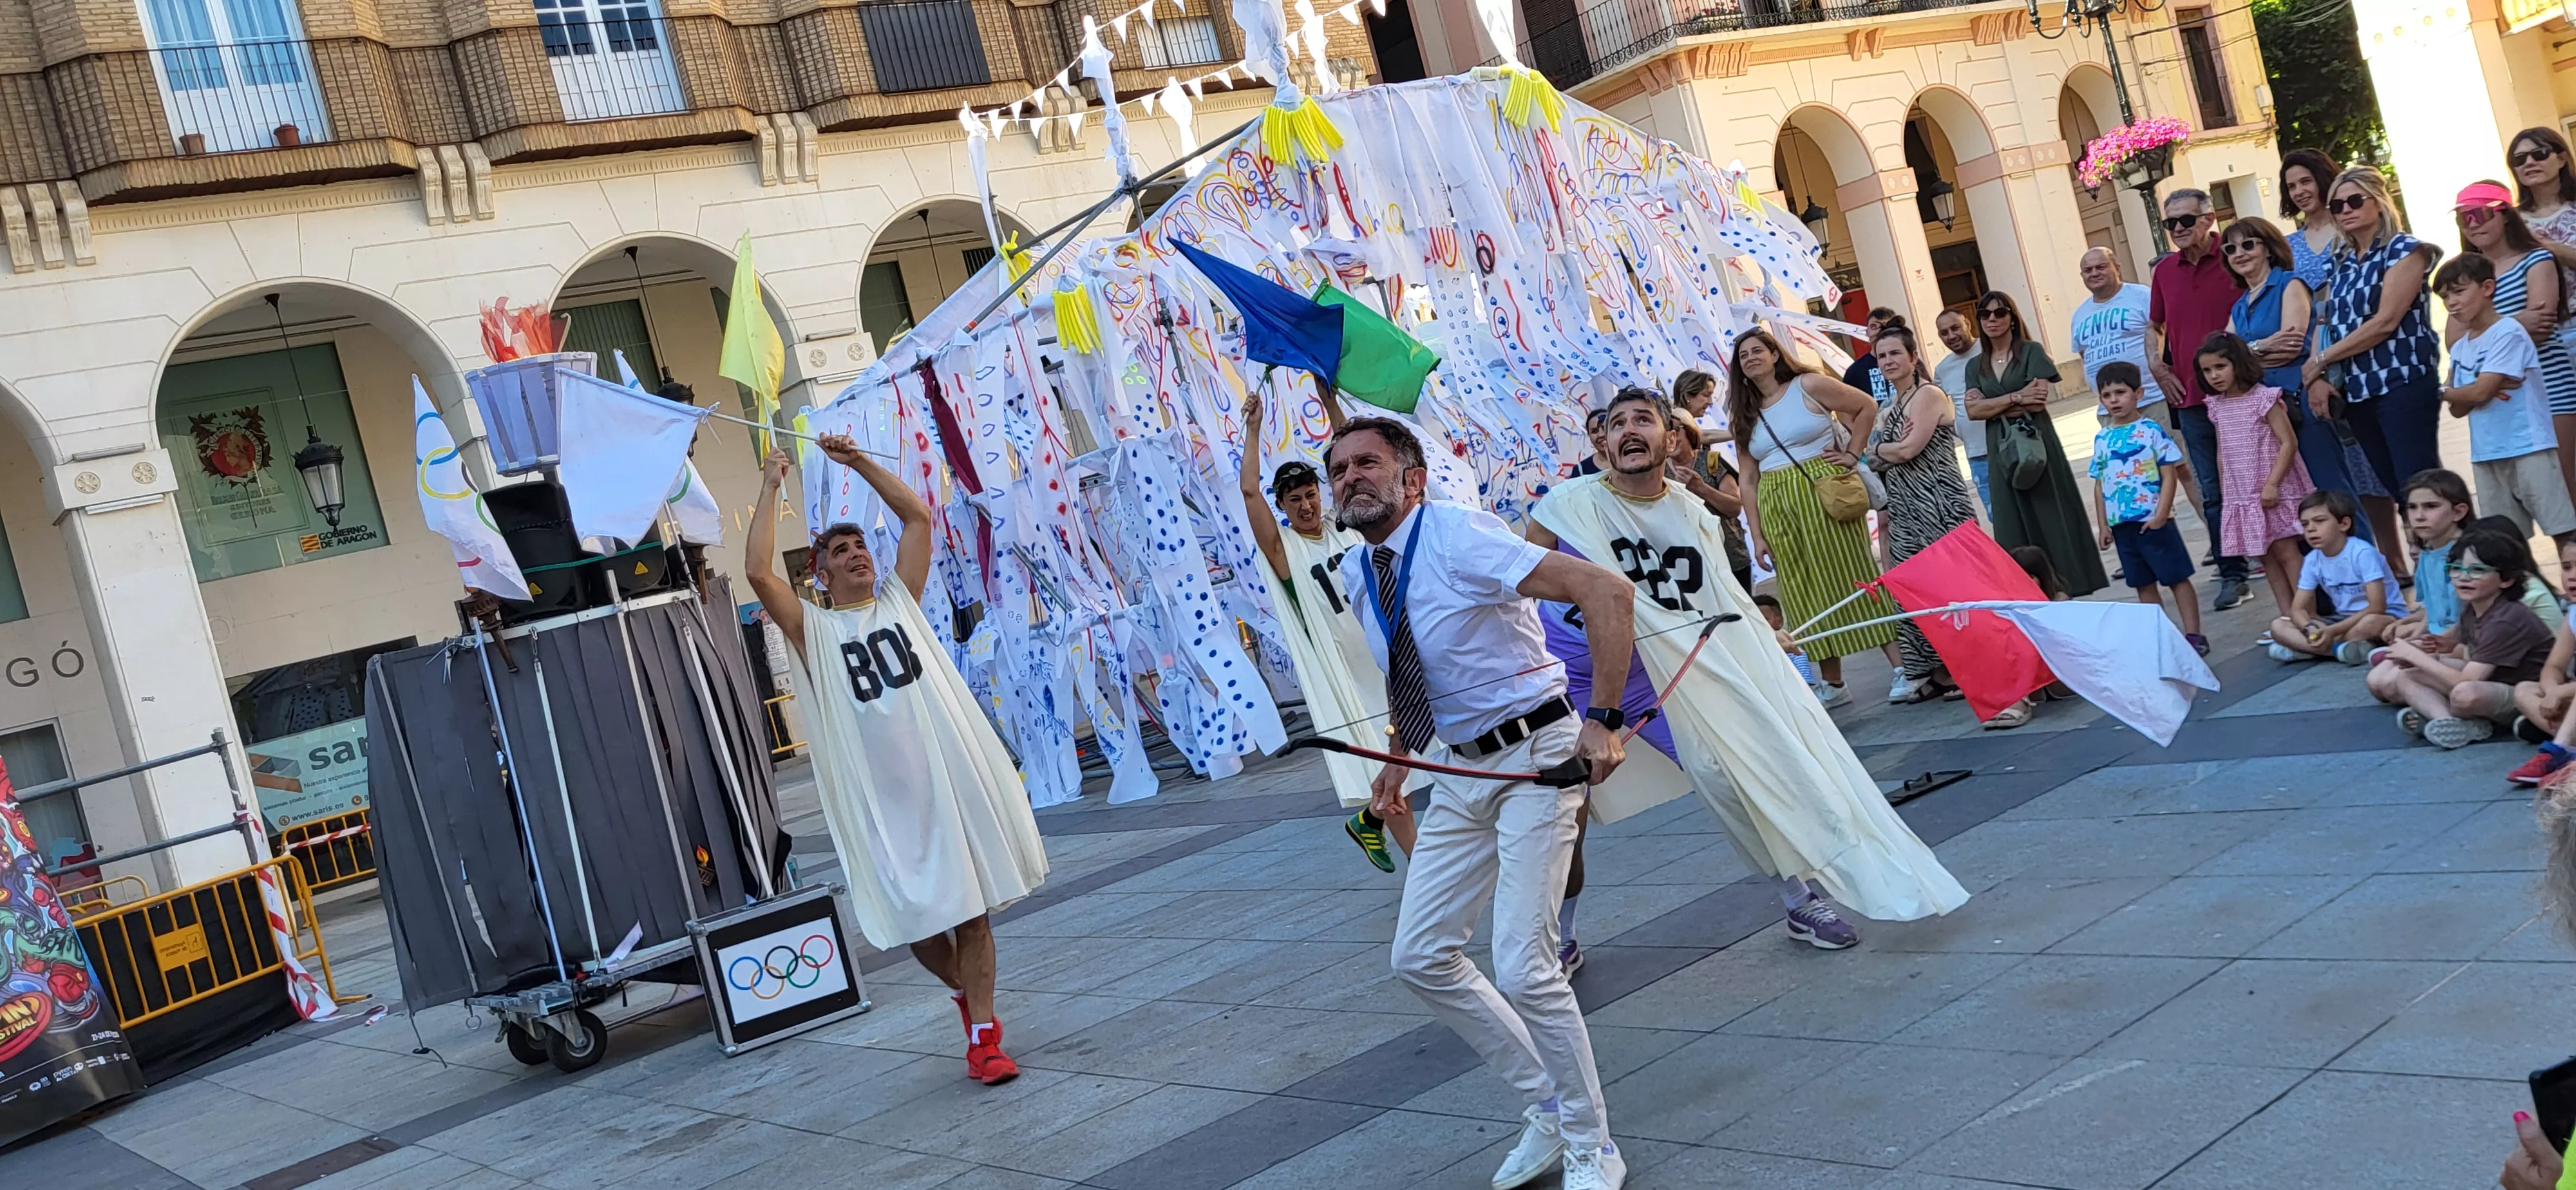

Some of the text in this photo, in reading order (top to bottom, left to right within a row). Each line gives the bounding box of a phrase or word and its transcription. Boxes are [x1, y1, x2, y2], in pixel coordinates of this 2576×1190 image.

[318, 524, 368, 541] GOBIERNO
[321, 540, 334, 549] DE
[304, 778, 327, 788] Nuestra
